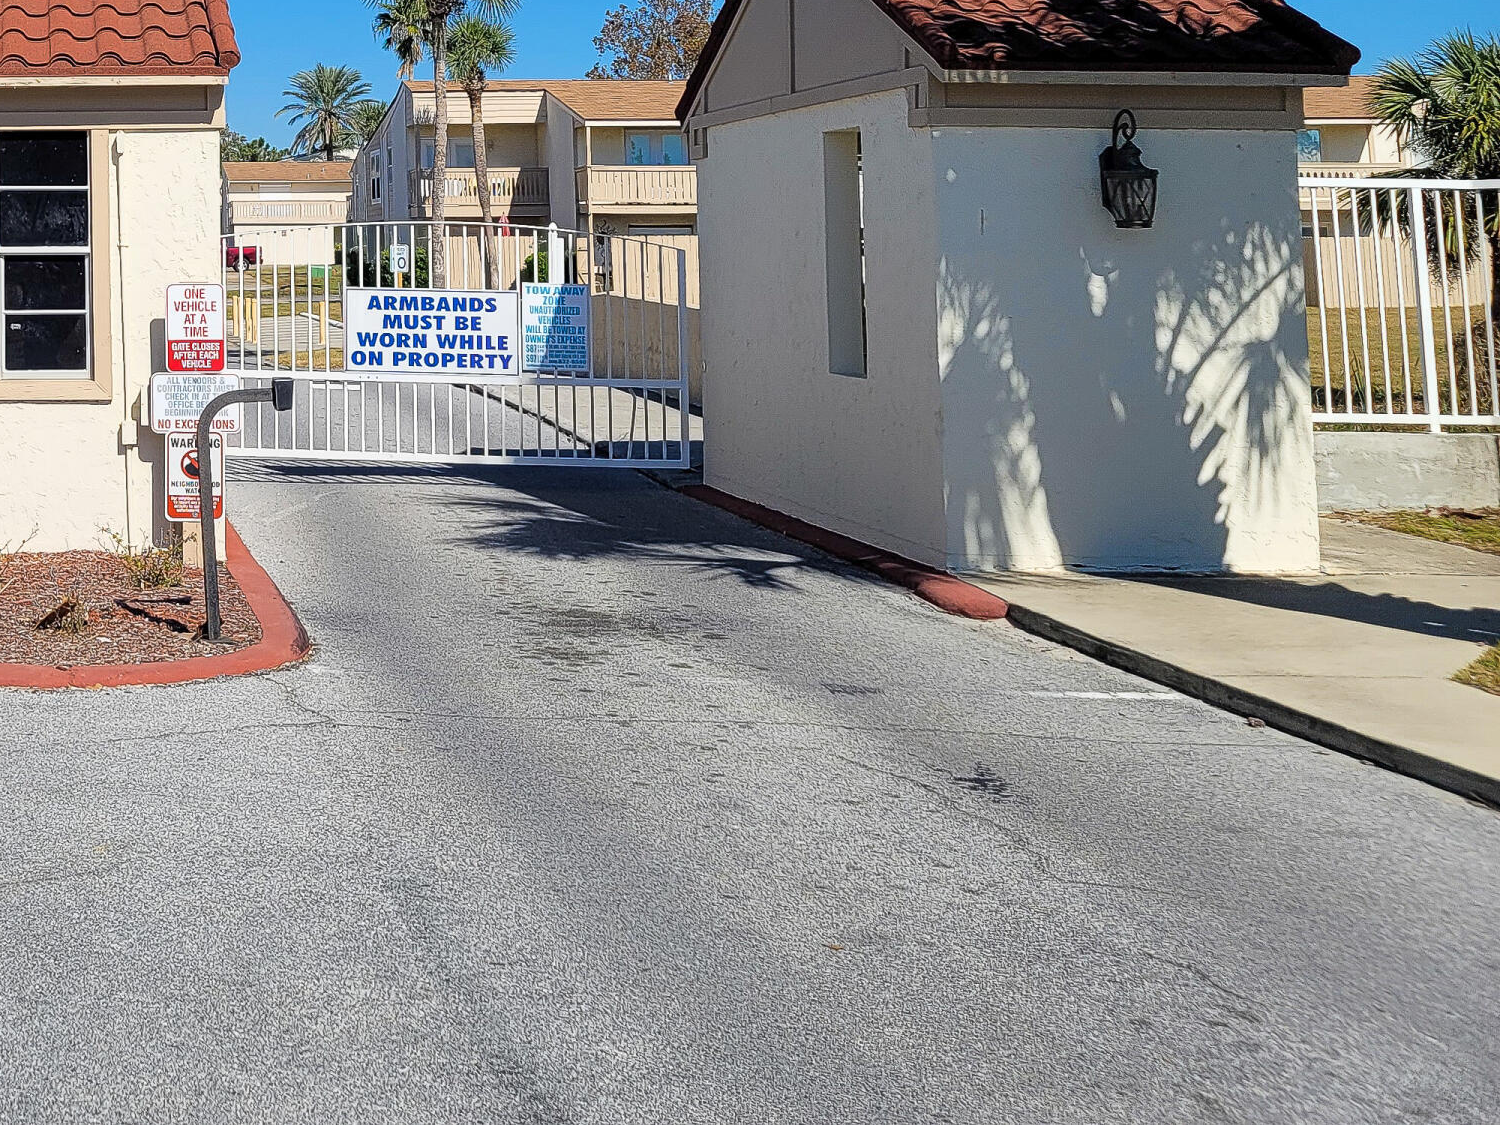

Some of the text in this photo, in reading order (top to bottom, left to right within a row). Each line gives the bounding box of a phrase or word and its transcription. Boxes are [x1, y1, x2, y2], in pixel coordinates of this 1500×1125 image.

[184, 288, 206, 299] ONE
[525, 285, 586, 296] TOW AWAY
[367, 295, 497, 312] ARMBANDS
[542, 296, 566, 306] ZONE
[173, 301, 217, 312] VEHICLE
[529, 305, 580, 316] UNAUTHORIZED
[184, 313, 207, 325] AT A
[382, 314, 482, 331] MUST BE
[538, 315, 571, 325] VEHICLES
[183, 326, 208, 337] TIME
[525, 325, 586, 335] WILL BE TOWED AT
[357, 332, 509, 351] WORN WHILE
[525, 335, 586, 344] OWNER'S EXPENSE
[171, 342, 220, 351] GATE CLOSES
[173, 351, 219, 360] AFTER EACH
[351, 350, 513, 370] ON PROPERTY
[181, 359, 212, 368] VEHICLE
[166, 376, 225, 385] ALL VENDORS &
[156, 385, 212, 393] CONTRACTORS
[157, 419, 235, 429] NO EXCEIONS
